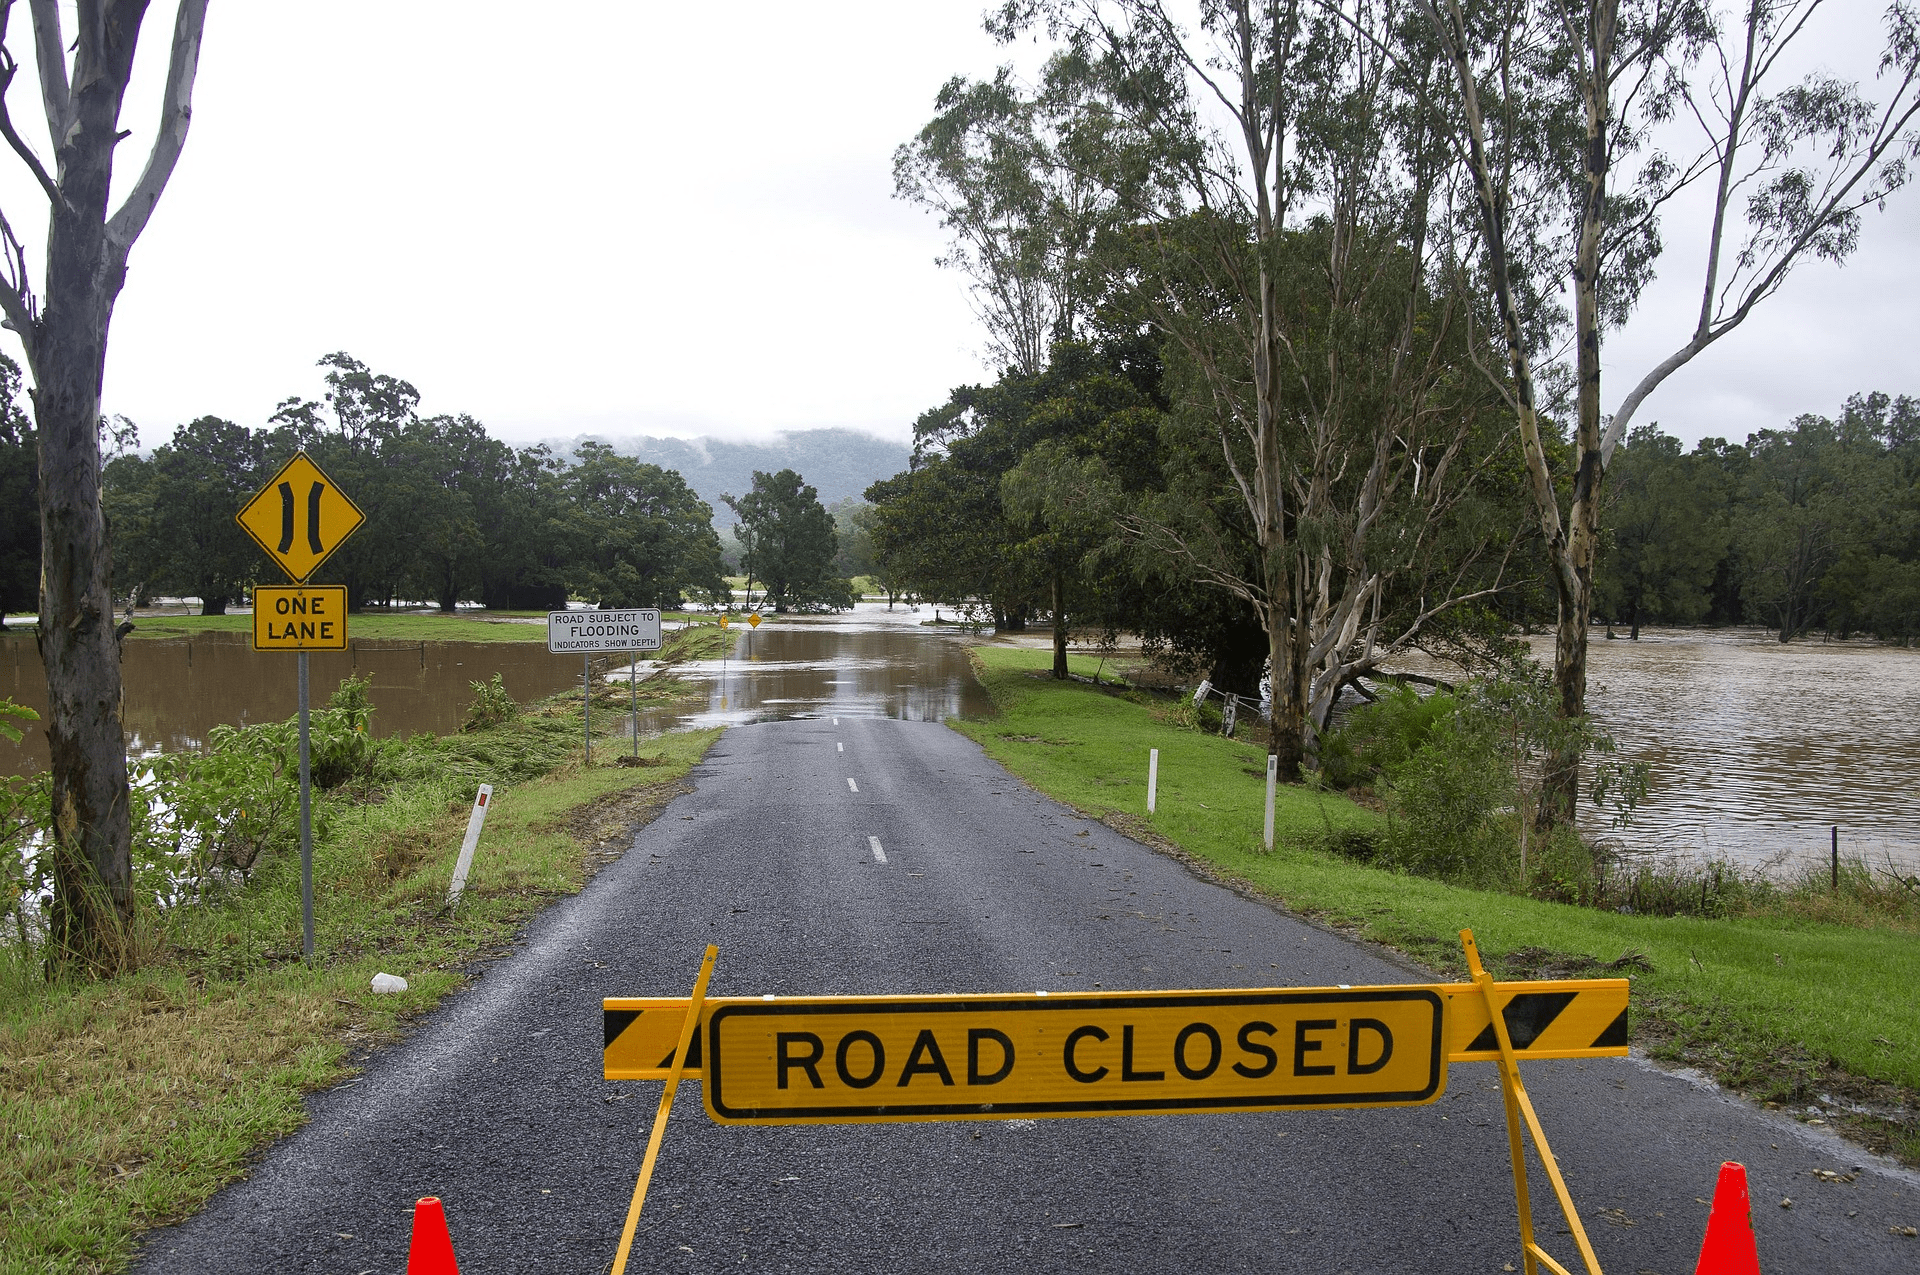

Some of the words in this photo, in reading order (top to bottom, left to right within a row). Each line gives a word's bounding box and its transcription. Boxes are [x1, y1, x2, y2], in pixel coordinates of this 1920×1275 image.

[275, 597, 325, 615] ONE
[555, 615, 585, 624] ROAD
[589, 613, 637, 623] SUBJECT
[641, 613, 654, 621] TO
[268, 622, 334, 639] LANE
[570, 625, 639, 637] FLOODING
[554, 640, 600, 649] INDICATORS
[605, 639, 627, 648] SHOW
[631, 638, 656, 647] DEPTH
[776, 1028, 1015, 1090] ROAD
[1063, 1018, 1394, 1084] CLOSED
